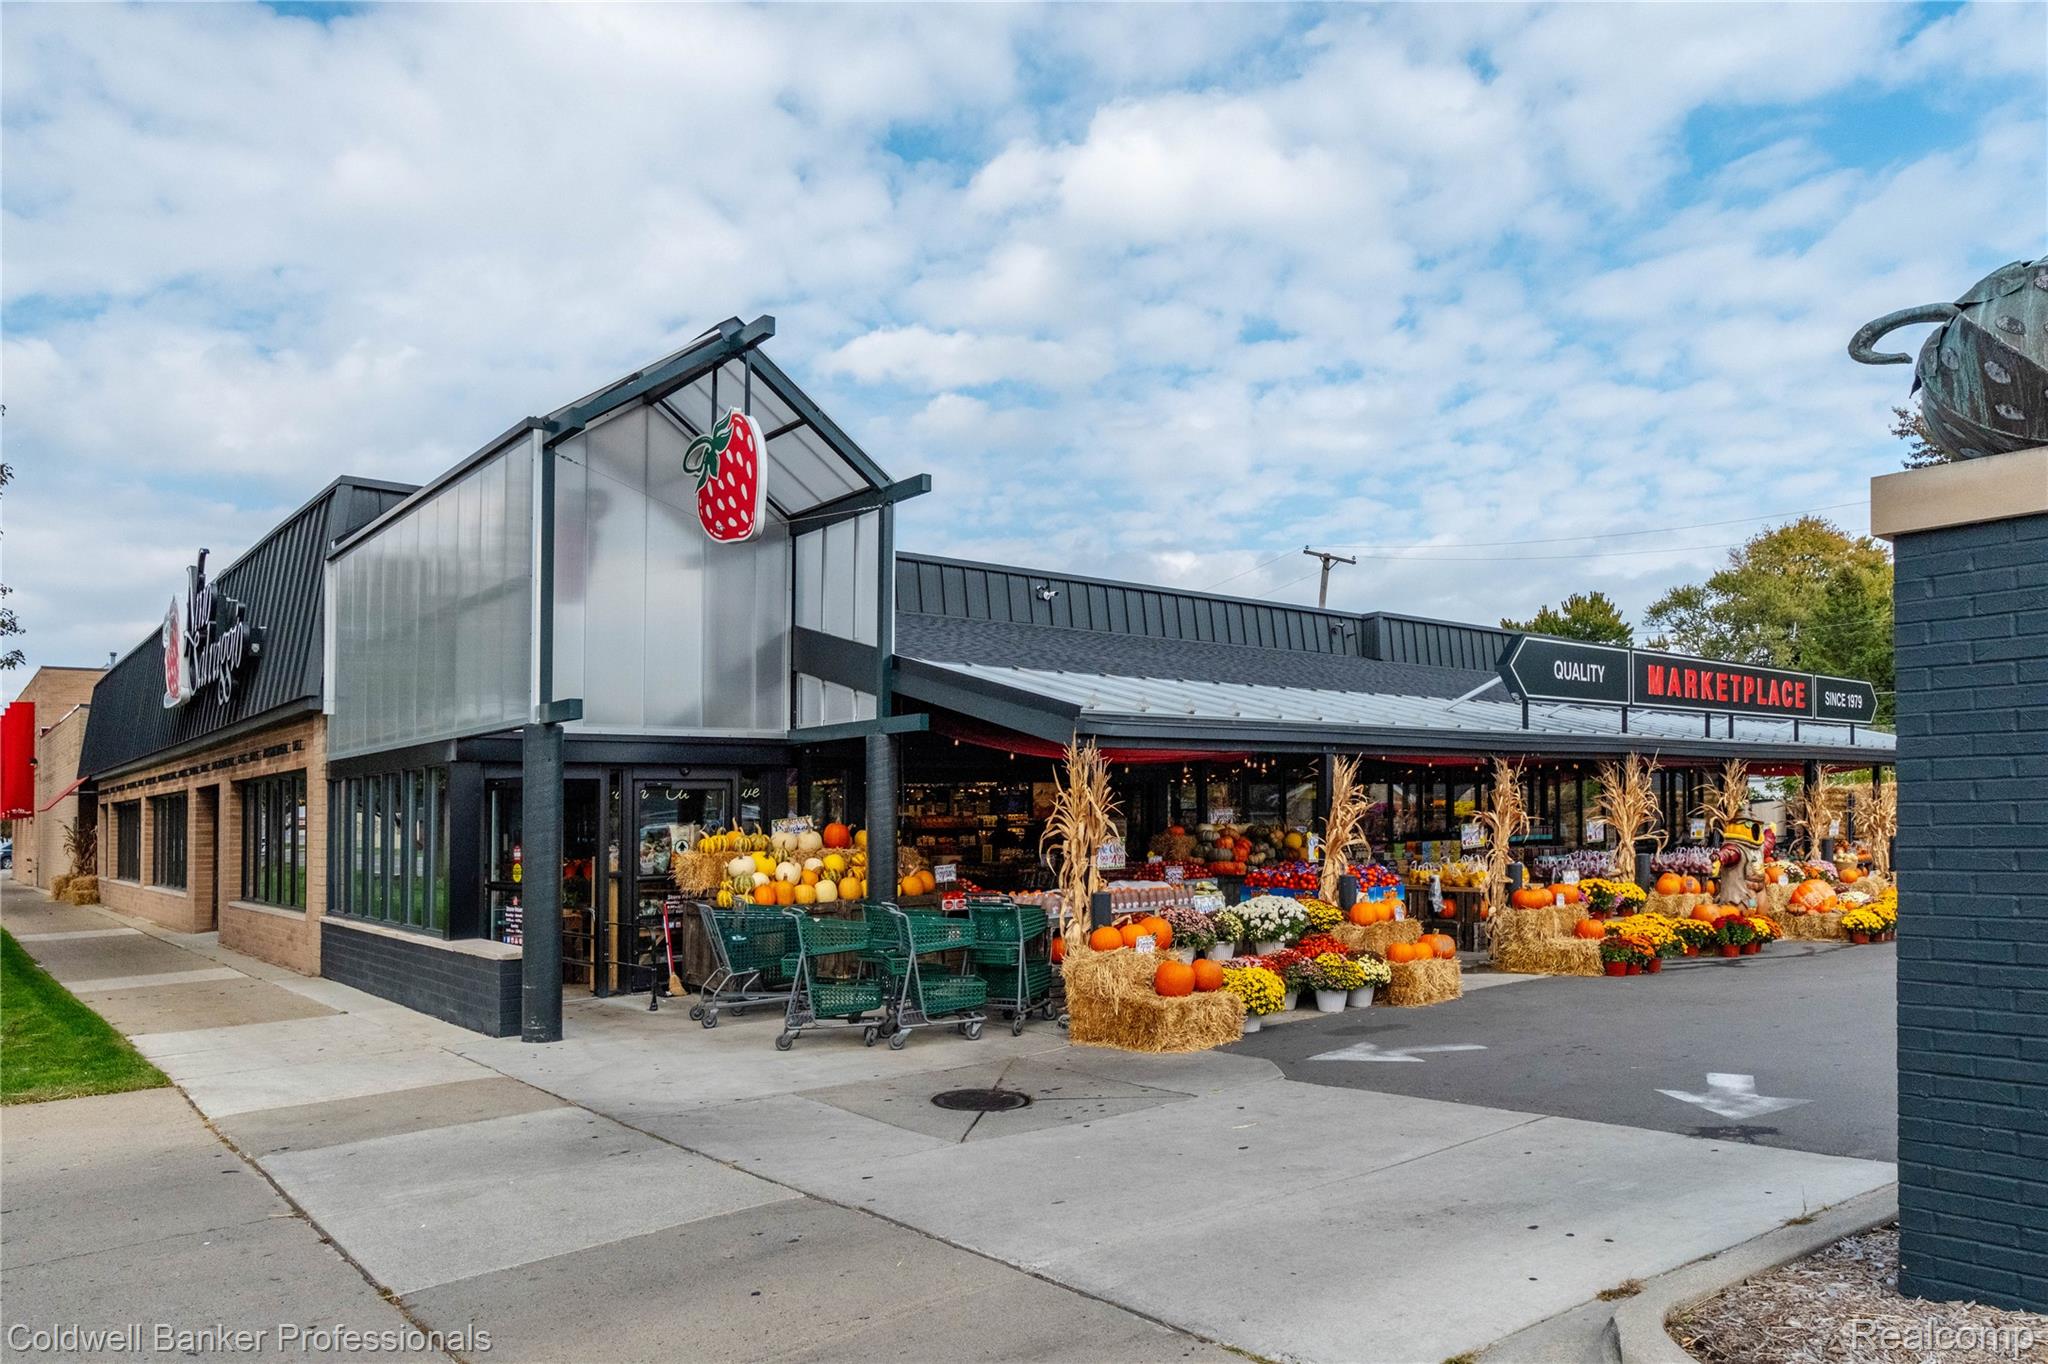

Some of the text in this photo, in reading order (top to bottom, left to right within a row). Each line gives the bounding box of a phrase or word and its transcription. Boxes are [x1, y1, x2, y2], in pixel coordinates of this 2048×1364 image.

[184, 618, 248, 706] Salvaggio
[1553, 659, 1606, 684] QUALITY
[1647, 664, 1807, 710] MARKETPLACE
[1824, 690, 1864, 710] SINCE 1979
